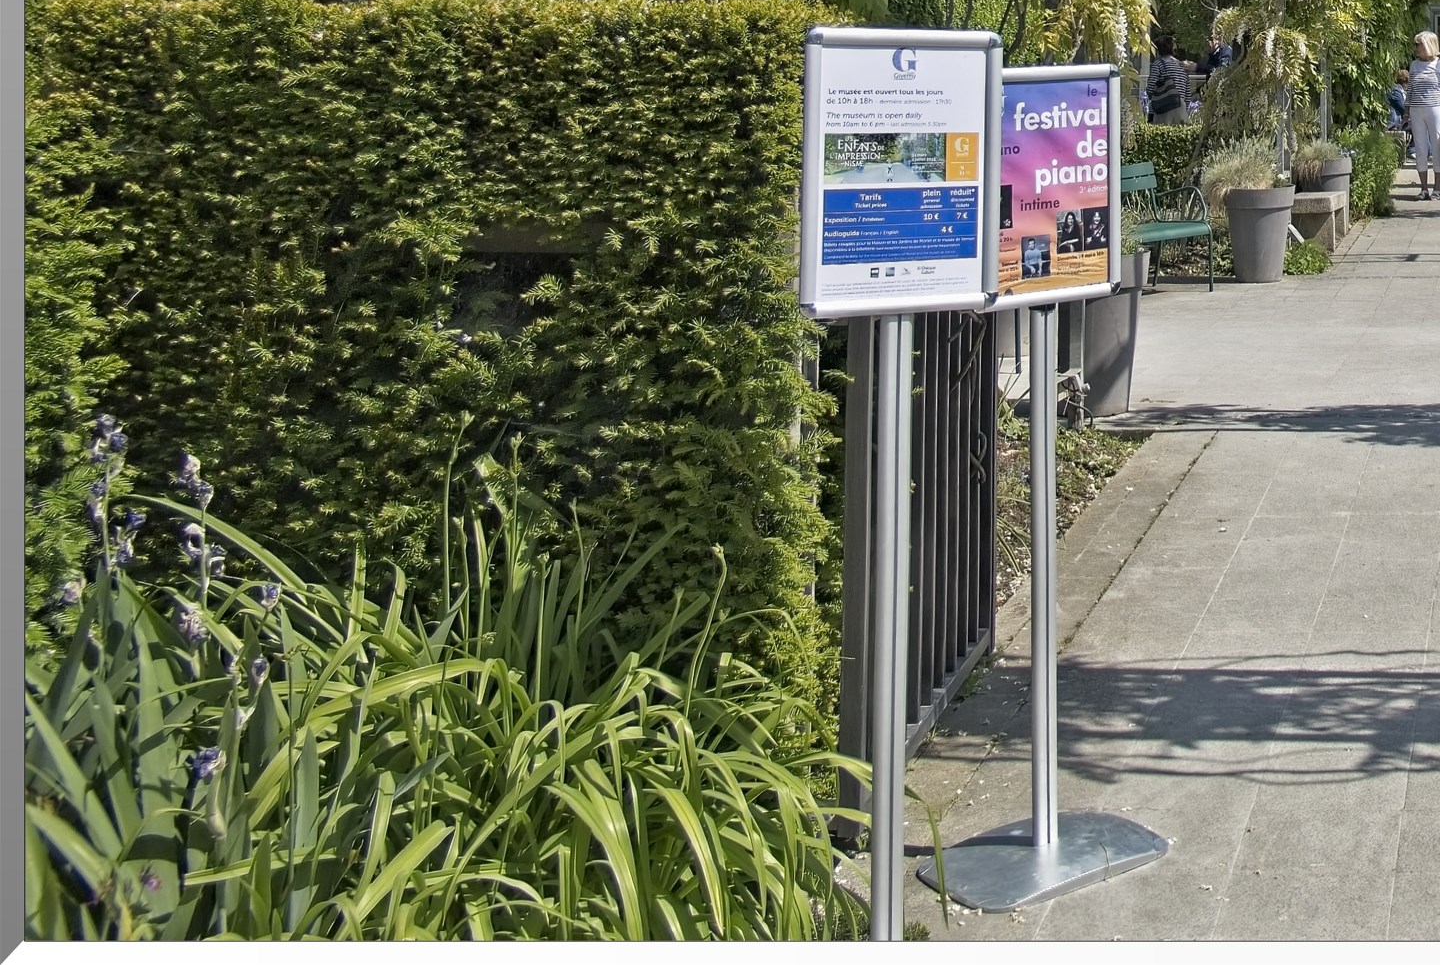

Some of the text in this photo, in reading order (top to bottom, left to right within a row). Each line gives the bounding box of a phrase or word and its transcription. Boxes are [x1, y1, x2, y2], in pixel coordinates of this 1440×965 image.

[892, 46, 918, 72] G
[926, 89, 944, 97] jours
[1087, 84, 1098, 97] le
[838, 97, 852, 105] 10h
[860, 97, 874, 105] 18h
[905, 112, 923, 120] daily
[1013, 97, 1107, 131] festival
[1076, 129, 1107, 159] de
[1035, 159, 1108, 194] piano
[860, 193, 882, 202] Tarifs
[922, 189, 941, 198] plein
[1020, 198, 1060, 211] intime
[923, 213, 933, 221] 10
[824, 230, 860, 238] Audioguide
